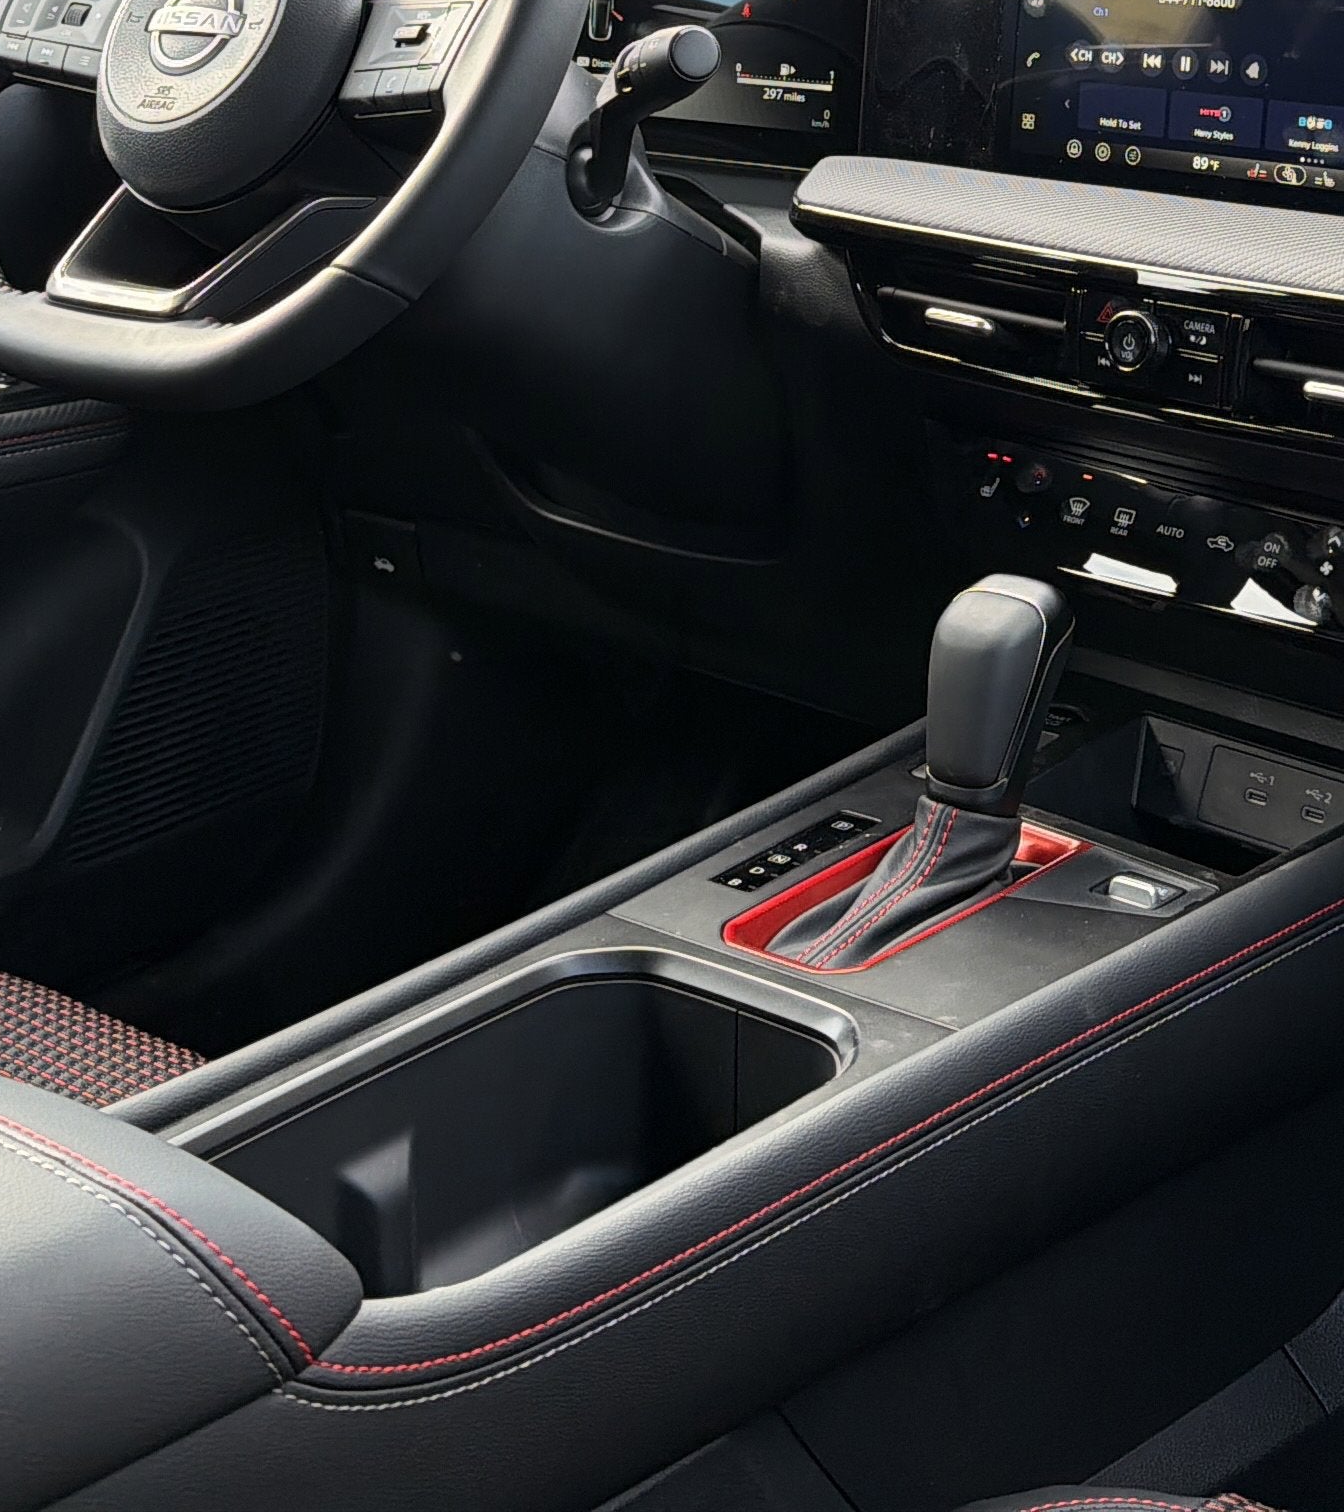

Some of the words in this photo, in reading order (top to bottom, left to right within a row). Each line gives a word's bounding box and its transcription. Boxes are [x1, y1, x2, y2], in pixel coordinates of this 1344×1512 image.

[762, 88, 784, 101] 297
[784, 92, 806, 103] miles
[1099, 117, 1118, 128] Hold
[1118, 118, 1128, 129] To
[1129, 119, 1142, 130] Set
[1183, 320, 1216, 335] CAMERA
[1121, 350, 1134, 362] VOL
[1063, 515, 1085, 527] FRONT
[1110, 527, 1129, 537] REAR
[1156, 524, 1185, 539] AUTO
[1264, 542, 1281, 554] ON
[1257, 556, 1278, 569] OFF
[1269, 774, 1276, 786] 1
[1324, 792, 1333, 804] 2
[749, 866, 765, 875] D
